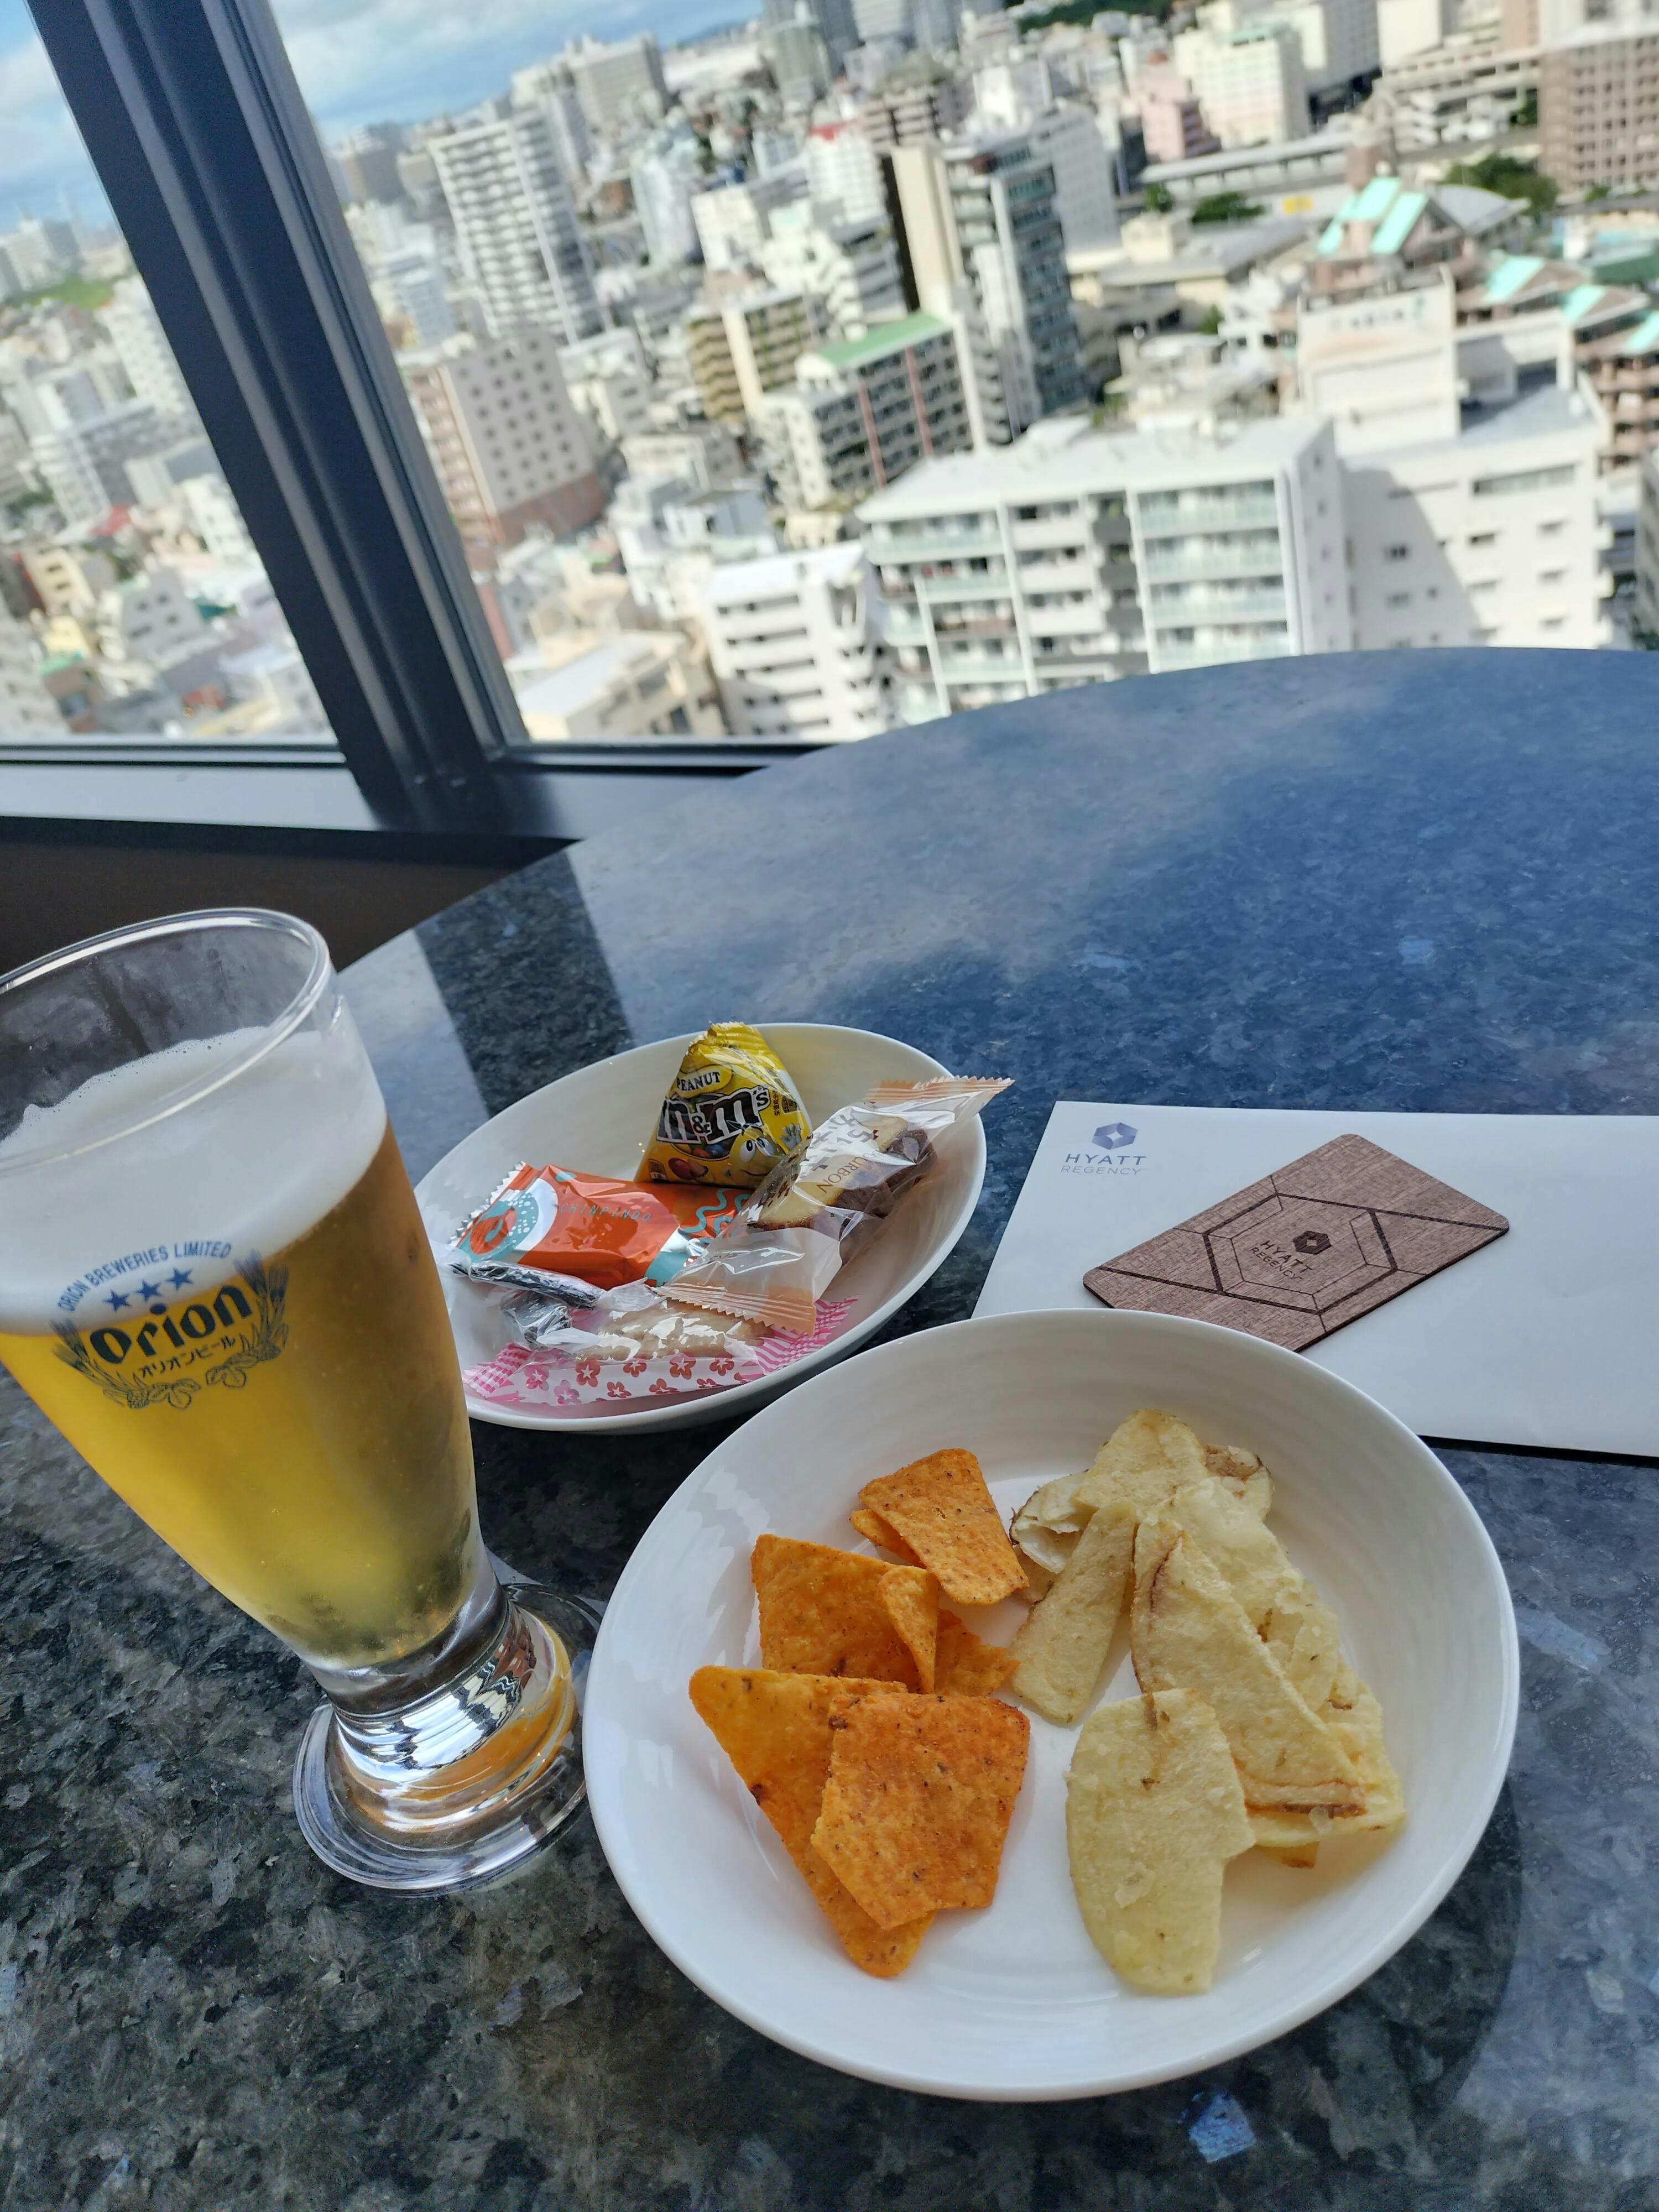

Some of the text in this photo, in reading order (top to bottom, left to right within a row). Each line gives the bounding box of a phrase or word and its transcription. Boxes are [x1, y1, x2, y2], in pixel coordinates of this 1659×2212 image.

[677, 1071, 721, 1091] PEANUT
[816, 1151, 879, 1193] OURBON
[1061, 1165, 1143, 1175] REGENCY
[1065, 1154, 1147, 1165] HYATT
[560, 1203, 652, 1222] CHINPINDO
[1250, 1246, 1303, 1279] REGENCY
[1260, 1240, 1313, 1273] HYATT
[58, 1240, 232, 1311] ORION BREWERIES LIMITED
[139, 1335, 236, 1378] オリオンビール
